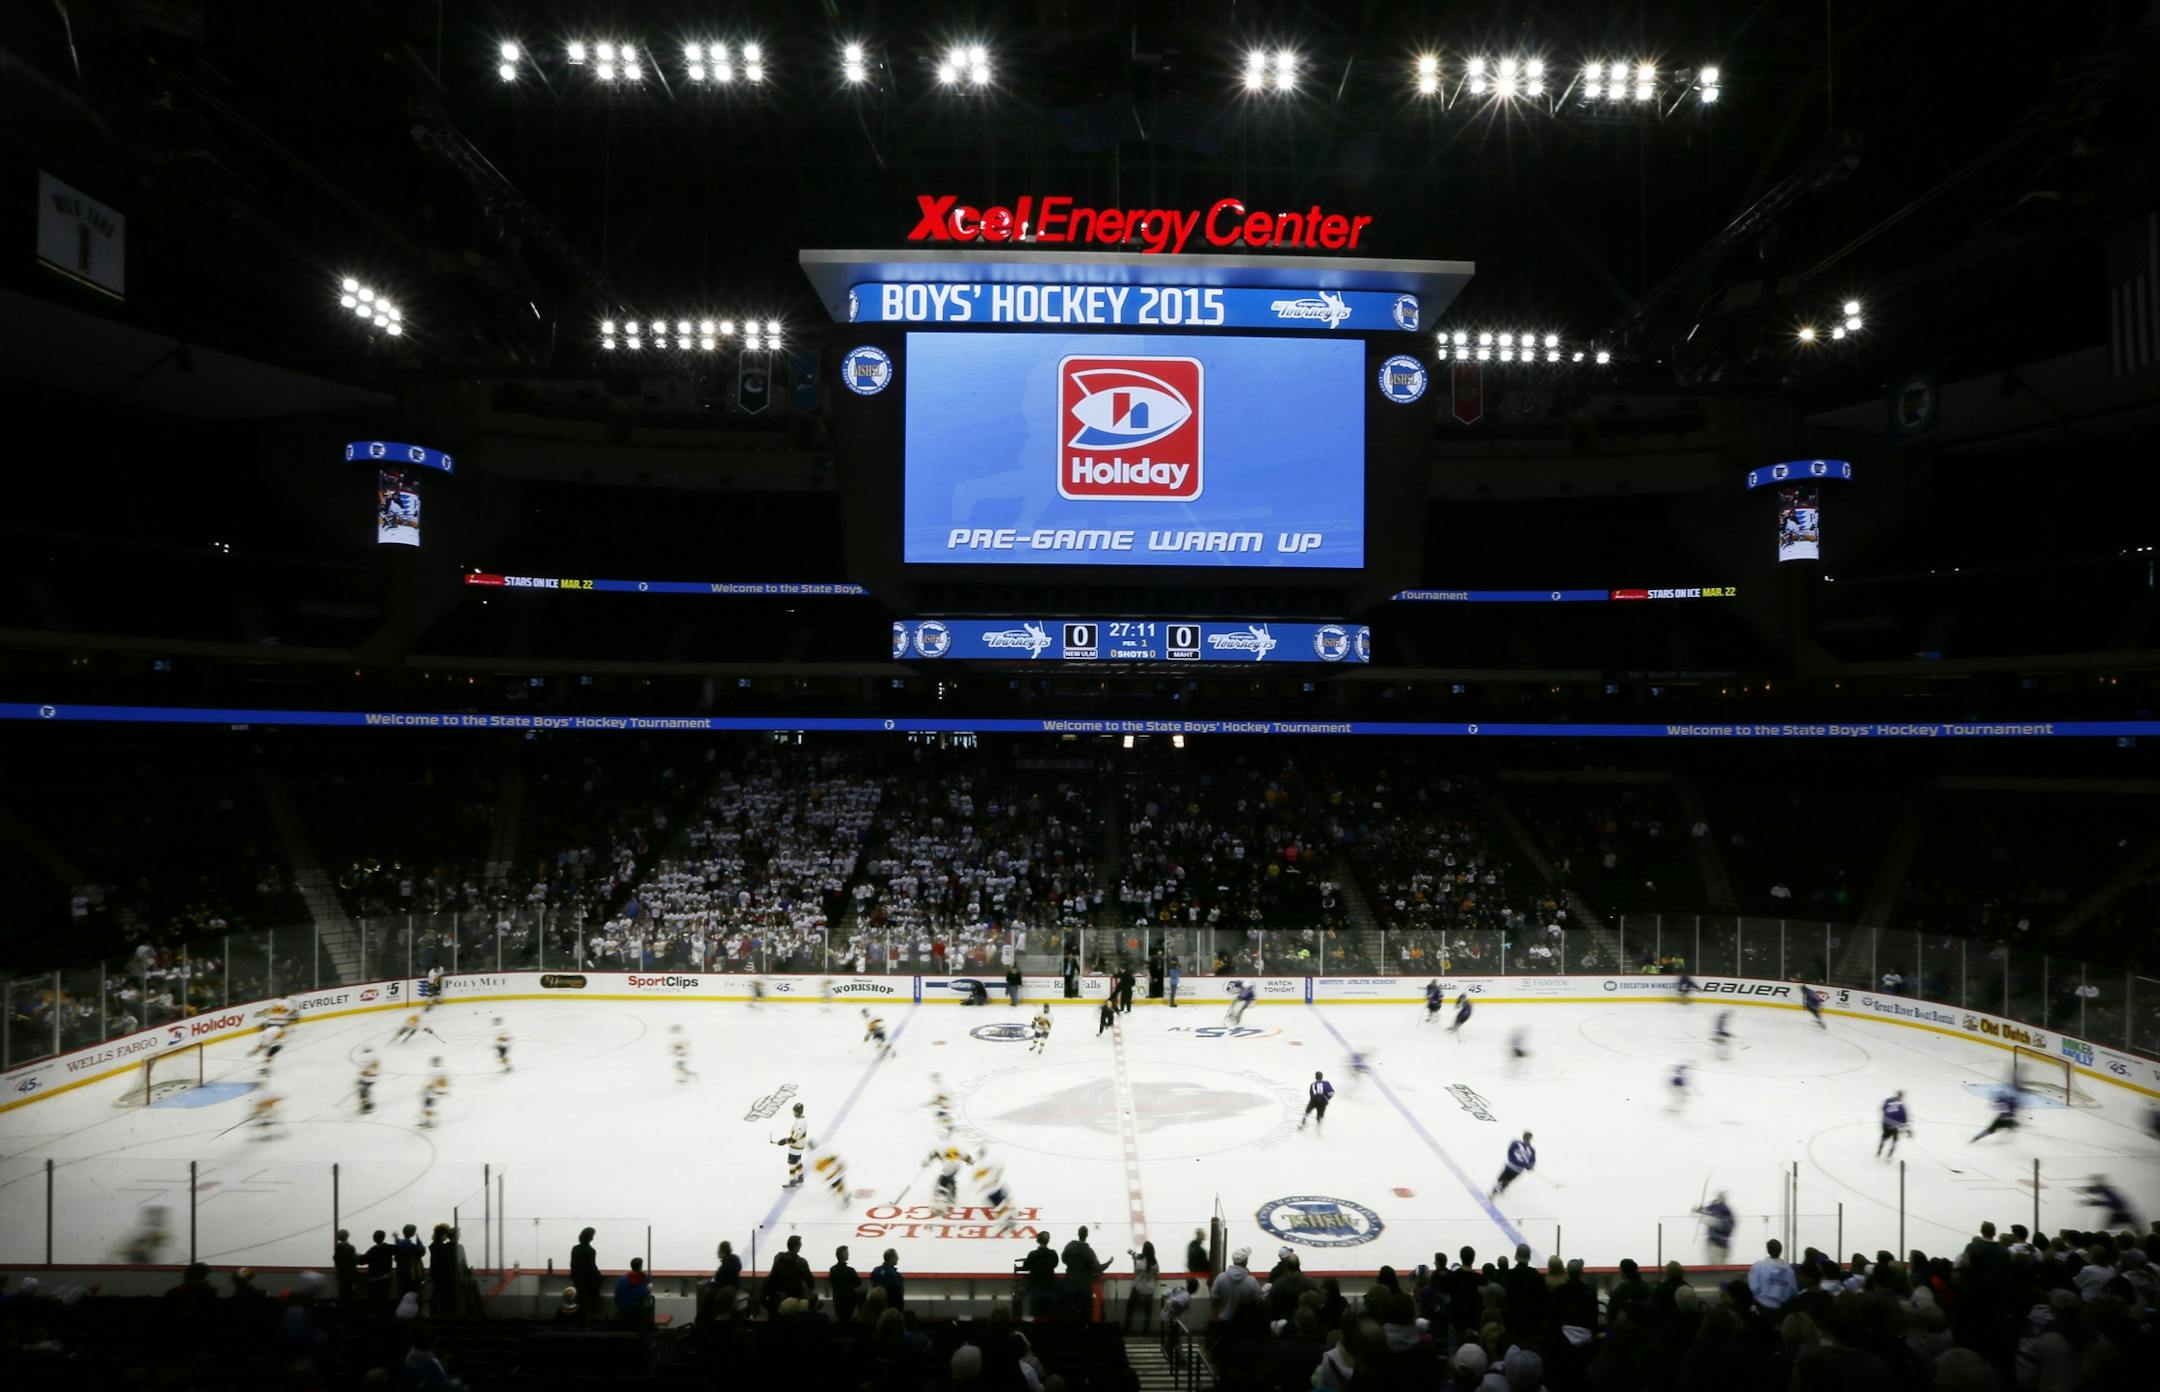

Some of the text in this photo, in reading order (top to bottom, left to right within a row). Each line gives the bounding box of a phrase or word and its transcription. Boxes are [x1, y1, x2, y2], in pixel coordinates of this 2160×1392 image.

[907, 195, 1372, 255] Xcel Energy Center
[882, 284, 1225, 325] BOYS' HOCKEY 2015
[1071, 457, 1189, 490] Holiday
[947, 528, 1323, 553] PRE-GAME WARM UP
[504, 576, 532, 587] STARS
[533, 577, 544, 588] ON
[545, 578, 559, 588] ICE
[560, 579, 582, 589] MAR.
[583, 580, 593, 590] 22
[711, 584, 763, 593] Welcome
[766, 585, 778, 593] to
[780, 584, 798, 593] the
[801, 585, 832, 593] State
[1400, 590, 1468, 601] Tournament
[1648, 590, 1674, 599] STARS
[1675, 589, 1687, 598] ON
[1687, 589, 1700, 598] ICE
[1703, 588, 1724, 597] MAR.
[1725, 587, 1736, 596] 22
[1072, 626, 1089, 646] 0
[1109, 623, 1155, 637] 27:11
[1176, 627, 1192, 647] 0
[1141, 639, 1147, 647] 1
[1110, 650, 1156, 658] 0 SHOTS 0
[366, 713, 711, 729] Welcome to the State Boys' Hockey Tournament
[1043, 720, 1351, 733] Welcome to the State Boys' Hockey Tournament
[1667, 722, 2054, 737] Welcome to the State Boys' Hockey Tournament
[628, 975, 699, 988] SportClips
[832, 983, 894, 995] WORKSHOP
[302, 994, 350, 1010] EVROLET
[191, 1013, 245, 1036] Holiday
[1980, 1018, 2031, 1044] Old Dutch
[66, 1050, 113, 1072] WELLS
[116, 1037, 158, 1060] FARGO
[855, 1222, 1041, 1240] WELLS
